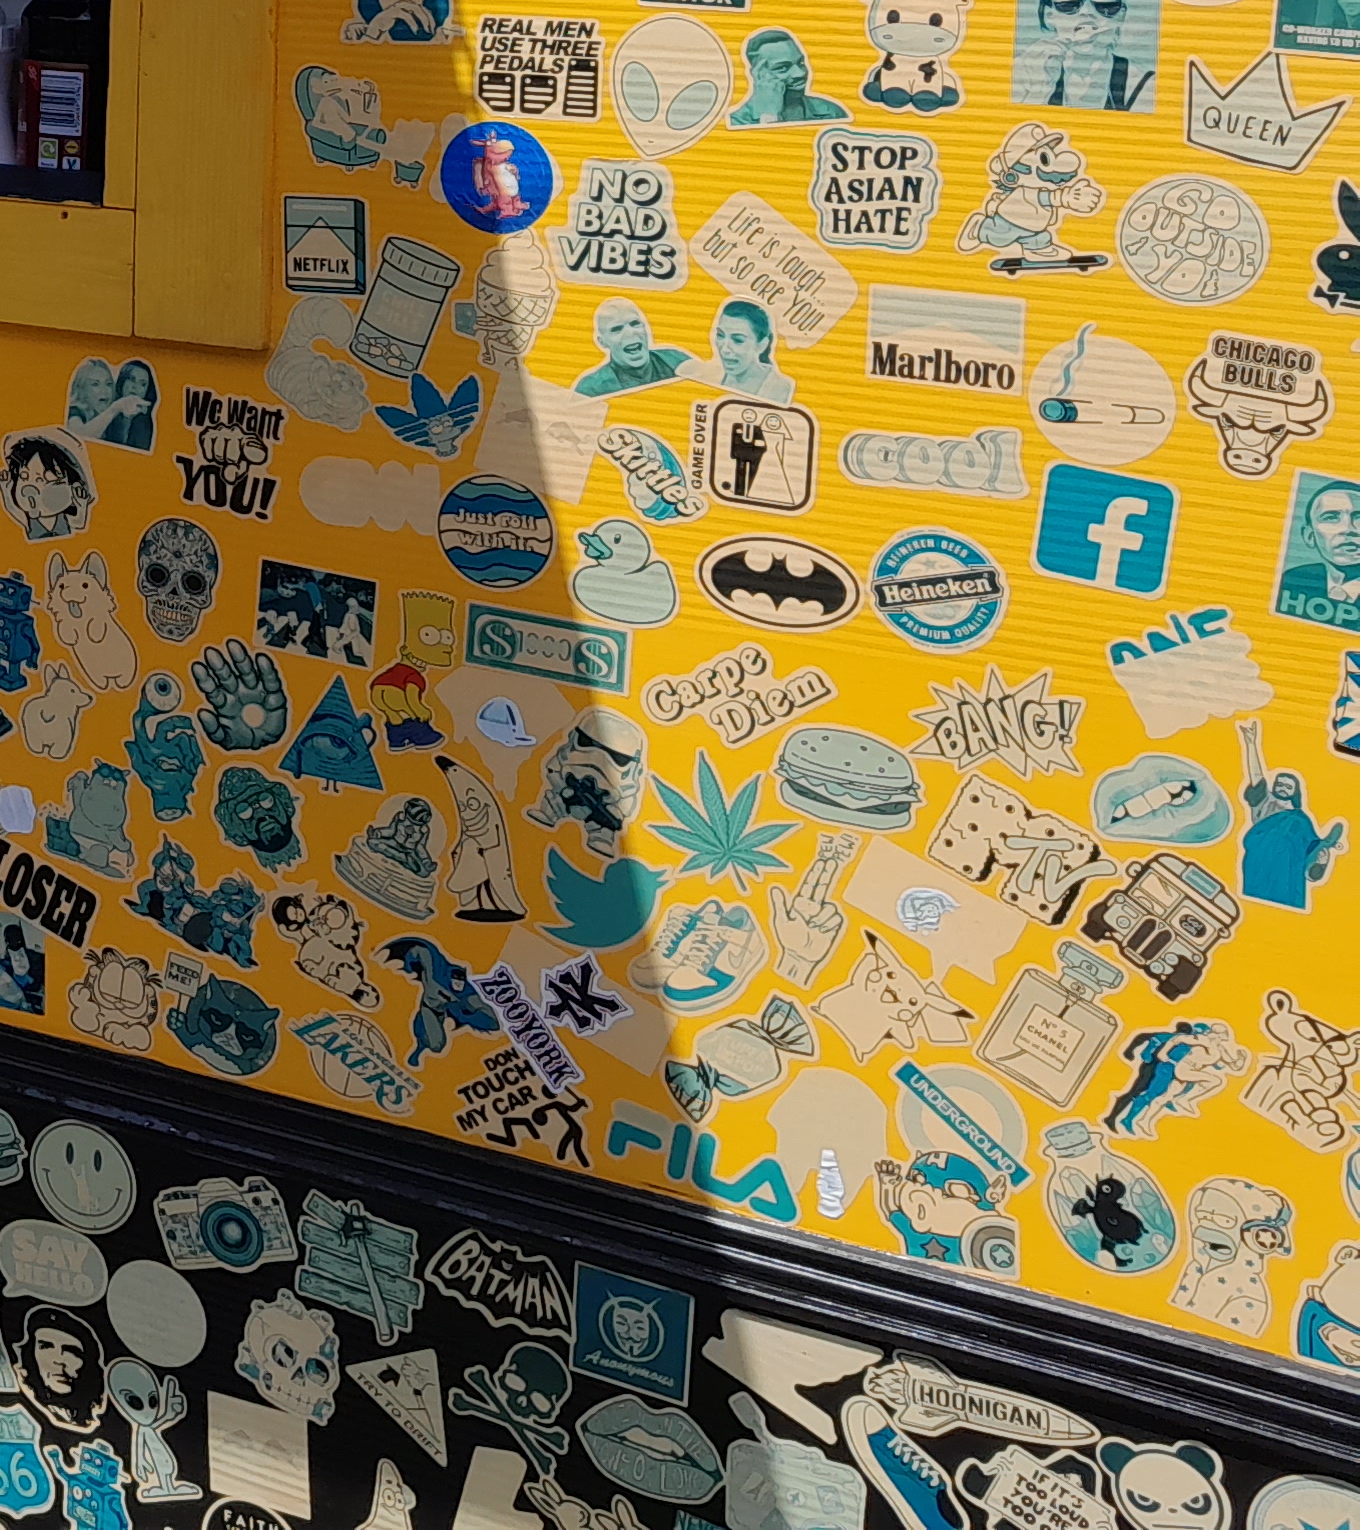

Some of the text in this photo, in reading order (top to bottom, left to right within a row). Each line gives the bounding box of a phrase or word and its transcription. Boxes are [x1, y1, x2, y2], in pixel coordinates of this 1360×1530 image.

[480, 19, 595, 40] REAL MEN
[480, 36, 601, 56] USE THREE
[480, 55, 564, 74] PEDALS
[1202, 106, 1292, 146] QUEEN
[831, 142, 919, 170] STOP
[589, 168, 662, 203] NO
[824, 175, 924, 204] ASIAN
[577, 203, 667, 240] BAD
[831, 207, 912, 236] HATE
[293, 256, 350, 275] NETFLIX
[560, 238, 675, 278] VIBES
[870, 341, 1015, 390] Marlboro
[1212, 335, 1315, 374] CHICAGO
[1223, 363, 1296, 395] BULLS
[185, 388, 283, 440] We Want
[692, 404, 708, 490] GAME OVER
[176, 455, 276, 519] YOU!
[882, 575, 992, 605] Heineken
[648, 649, 766, 722] Carpe
[712, 672, 830, 742] Diem
[936, 698, 1078, 758] BANG!
[1027, 1024, 1069, 1055] CHANEL
[293, 1016, 413, 1110] LAKERS
[458, 1061, 536, 1105] TOUCH
[457, 1086, 537, 1130] MY CAR
[909, 1074, 1017, 1173] UNDERGROUND
[444, 1233, 569, 1326] BATMAN
